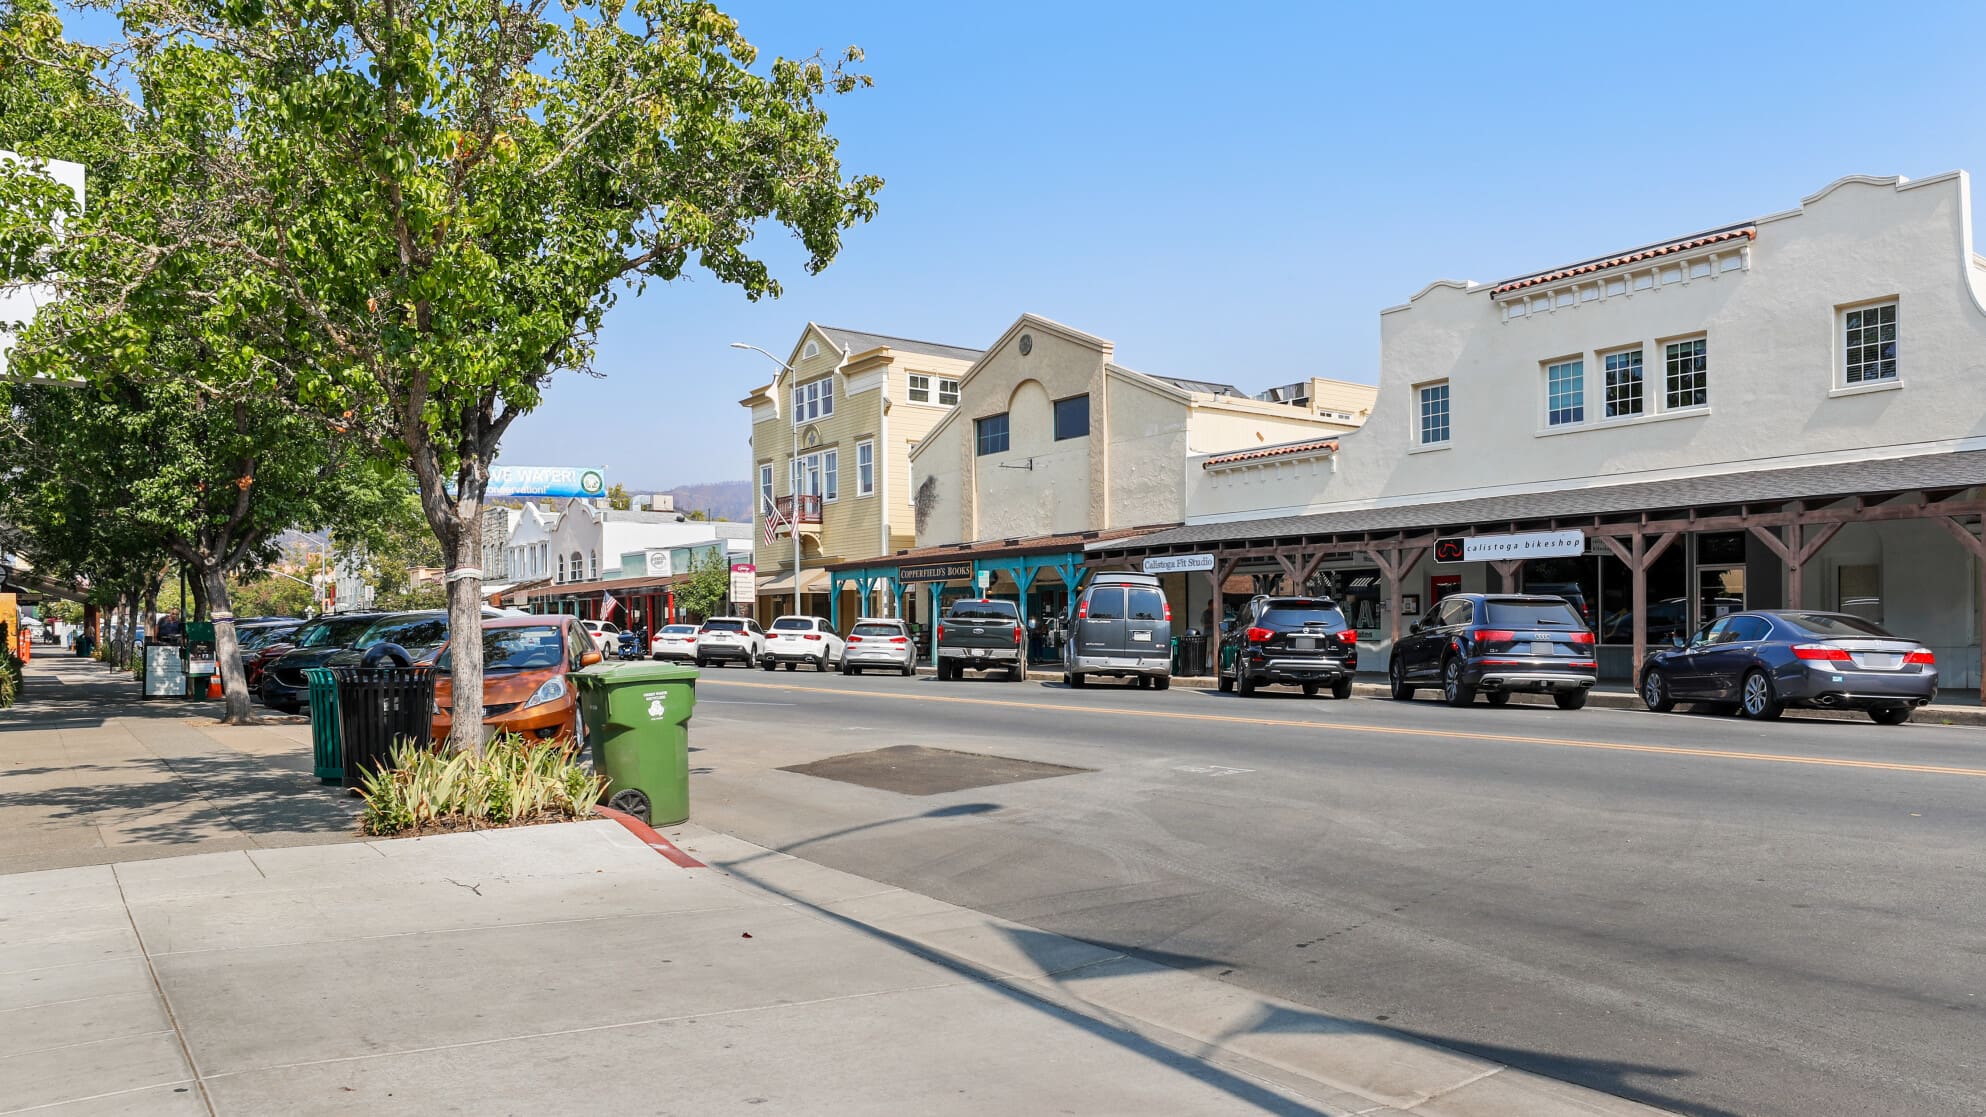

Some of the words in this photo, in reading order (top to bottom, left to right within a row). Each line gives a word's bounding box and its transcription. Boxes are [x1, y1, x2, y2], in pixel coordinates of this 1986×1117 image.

[520, 470, 576, 483] WATER!
[1467, 543, 1519, 552] calistoga
[1524, 538, 1580, 549] bikeshop
[1145, 559, 1176, 570] Calistoga
[1177, 558, 1187, 568] Fit
[1188, 557, 1213, 567] Studio
[900, 567, 946, 579] COPPERFIELD'S
[947, 566, 970, 576] BOOKS
